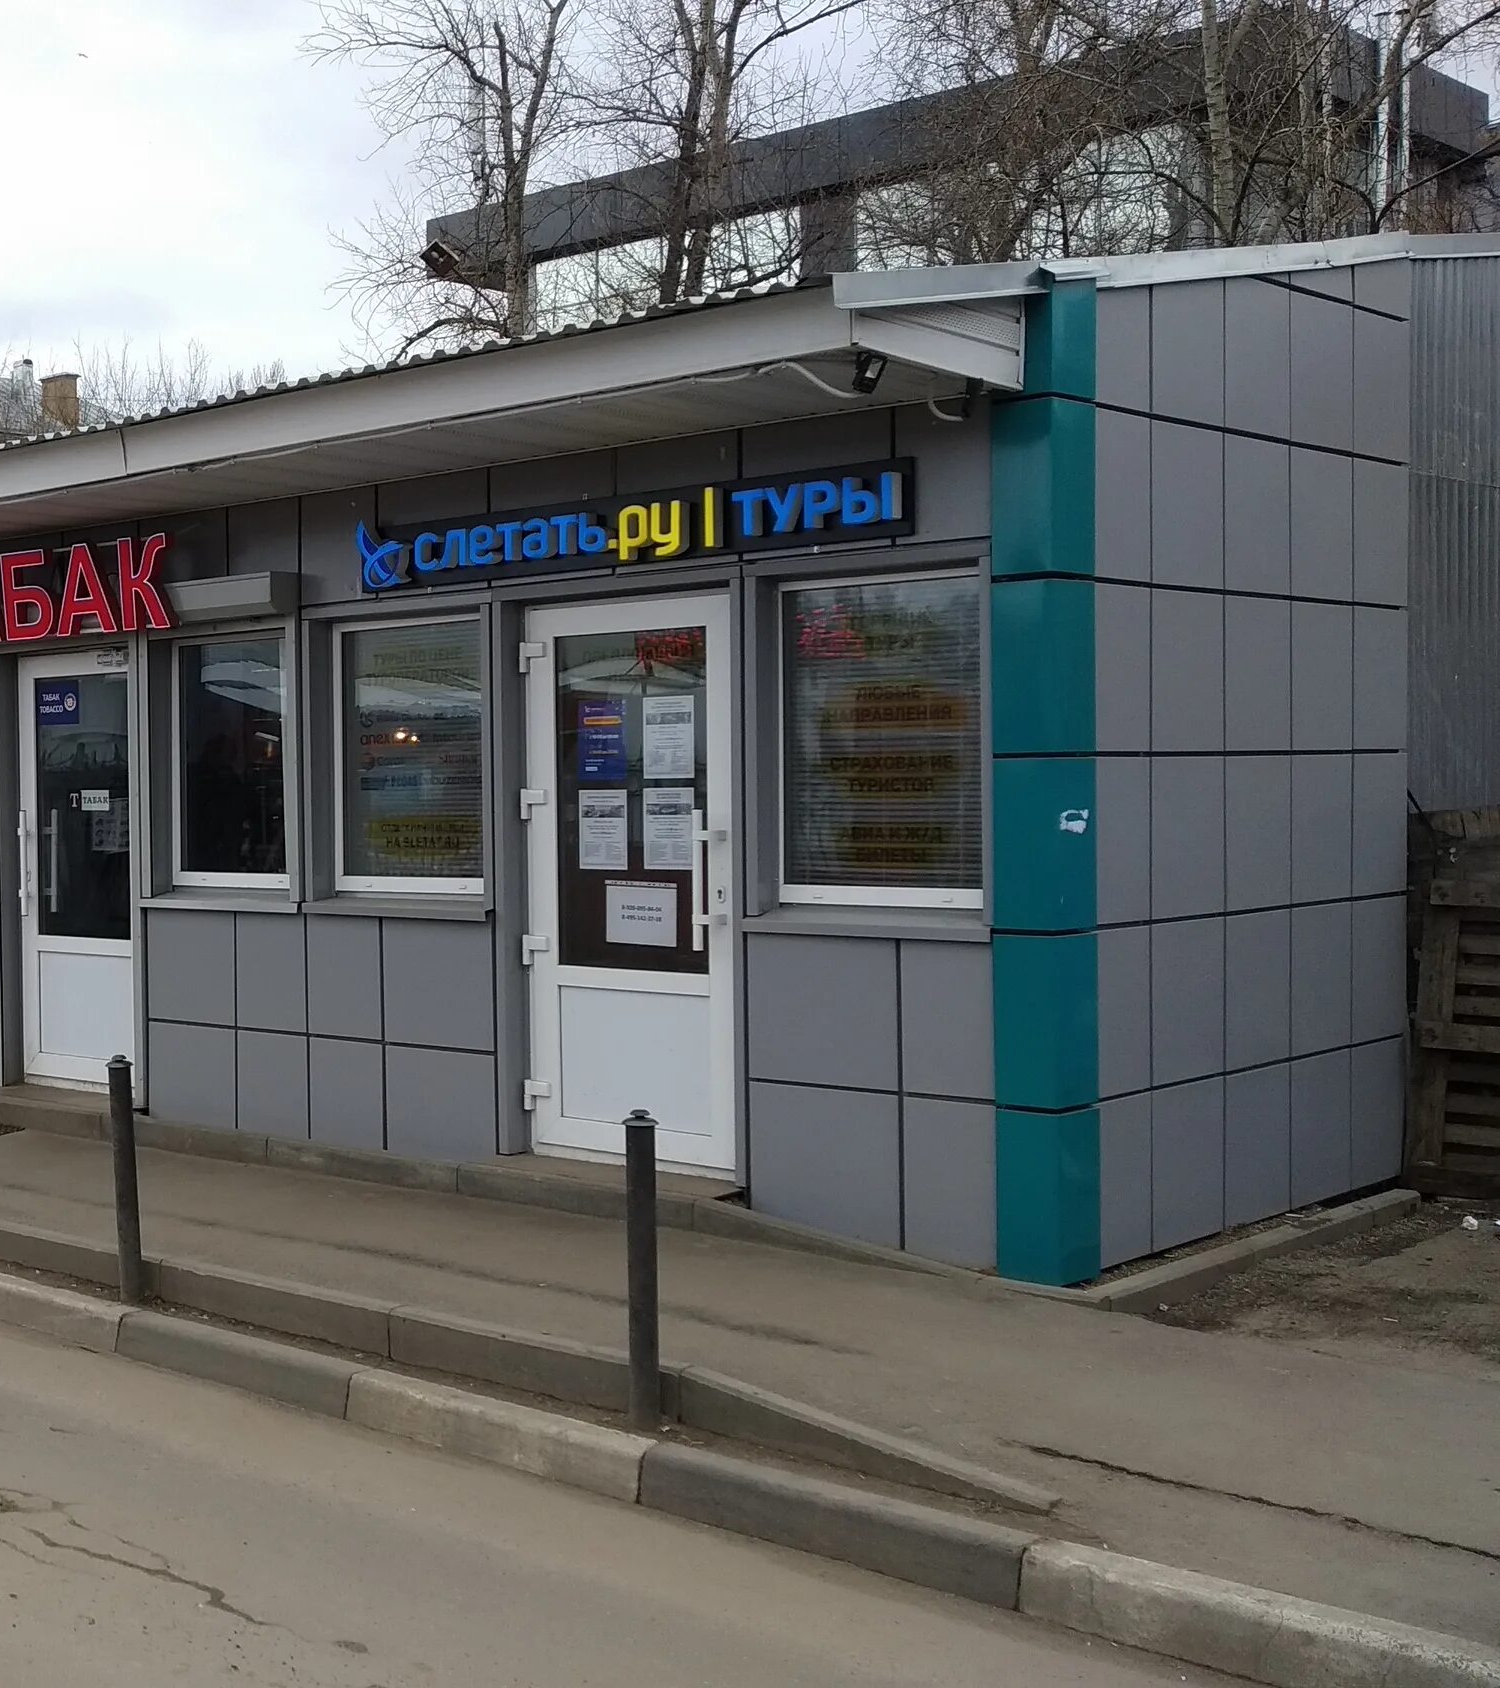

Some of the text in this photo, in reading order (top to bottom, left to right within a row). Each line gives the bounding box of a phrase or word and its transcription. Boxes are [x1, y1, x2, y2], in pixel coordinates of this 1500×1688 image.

[42, 693, 61, 702] ТАБАК
[39, 704, 64, 714] TOBACCO
[83, 795, 109, 805] ТАБАК
